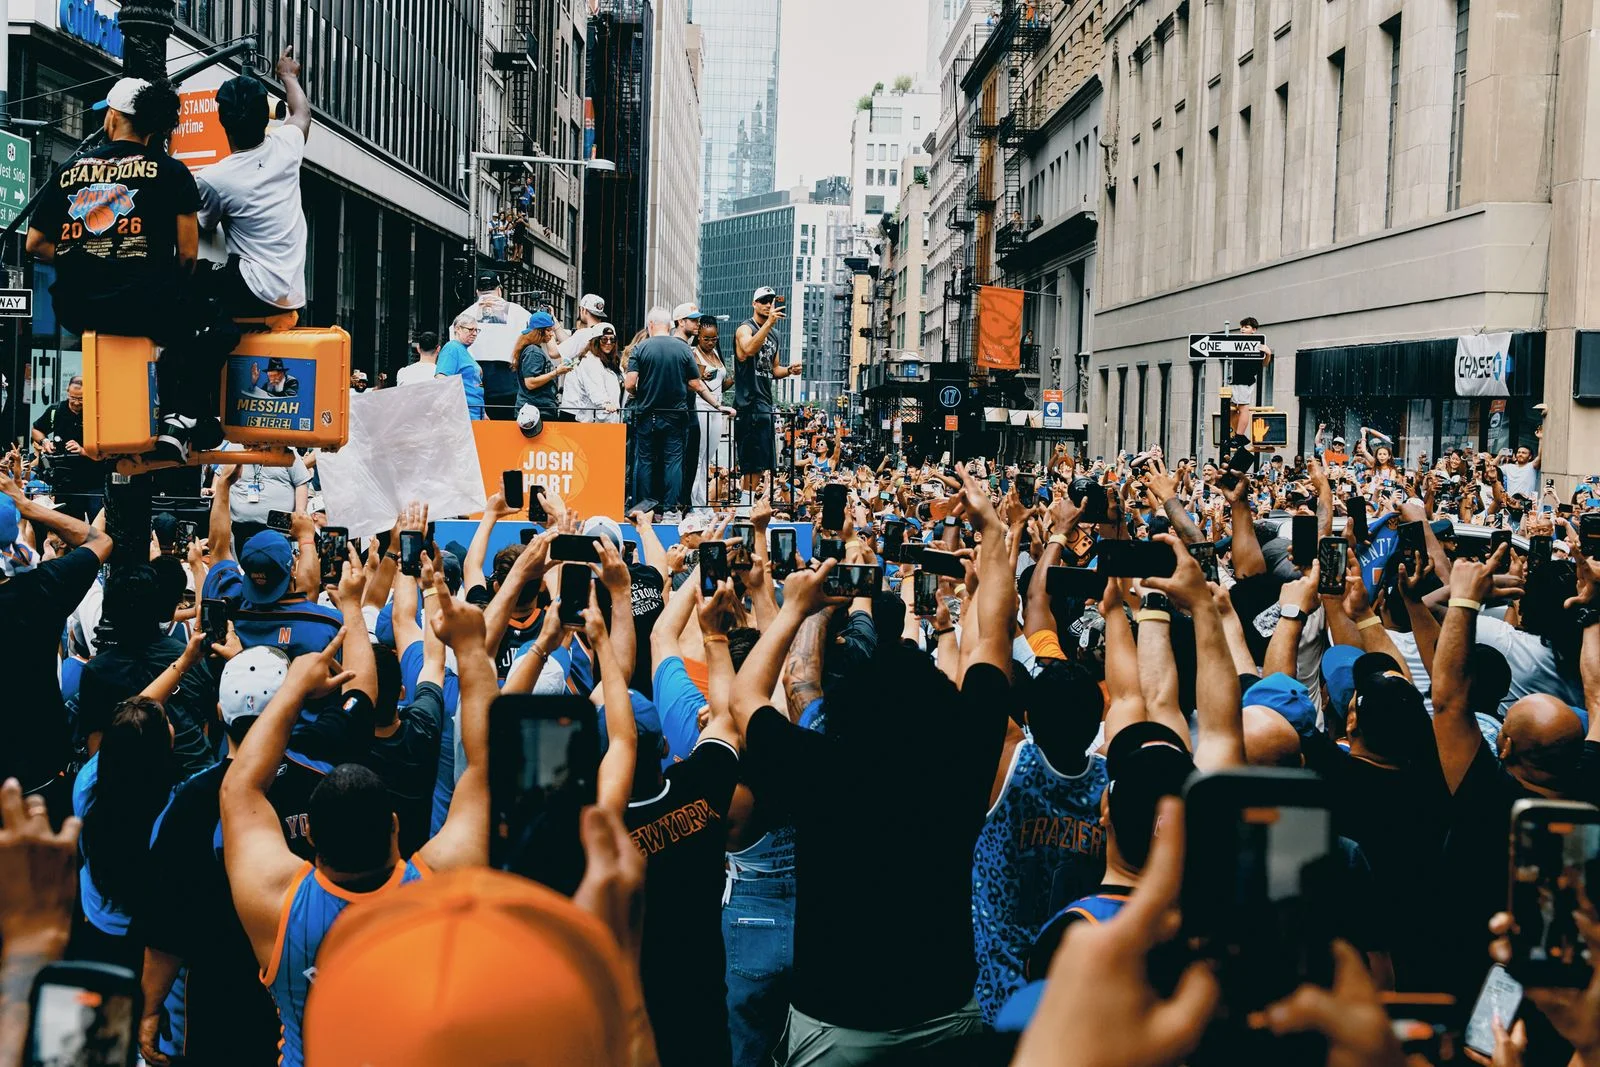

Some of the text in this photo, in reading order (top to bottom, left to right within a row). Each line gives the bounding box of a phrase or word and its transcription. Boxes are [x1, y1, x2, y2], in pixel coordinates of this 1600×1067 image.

[184, 98, 220, 115] STANDIN
[13, 168, 26, 184] Side
[60, 160, 158, 189] CHAMPIONS
[61, 216, 142, 240] 20 26
[1200, 341, 1258, 351] ONE WAY
[1458, 355, 1494, 378] CHASE
[237, 398, 300, 415] MESSIAH
[944, 389, 957, 405] 17
[248, 416, 291, 429] IS HERE!
[523, 450, 574, 472] JOSH
[285, 813, 309, 838] YO
[1019, 816, 1103, 857] FRAZIER
